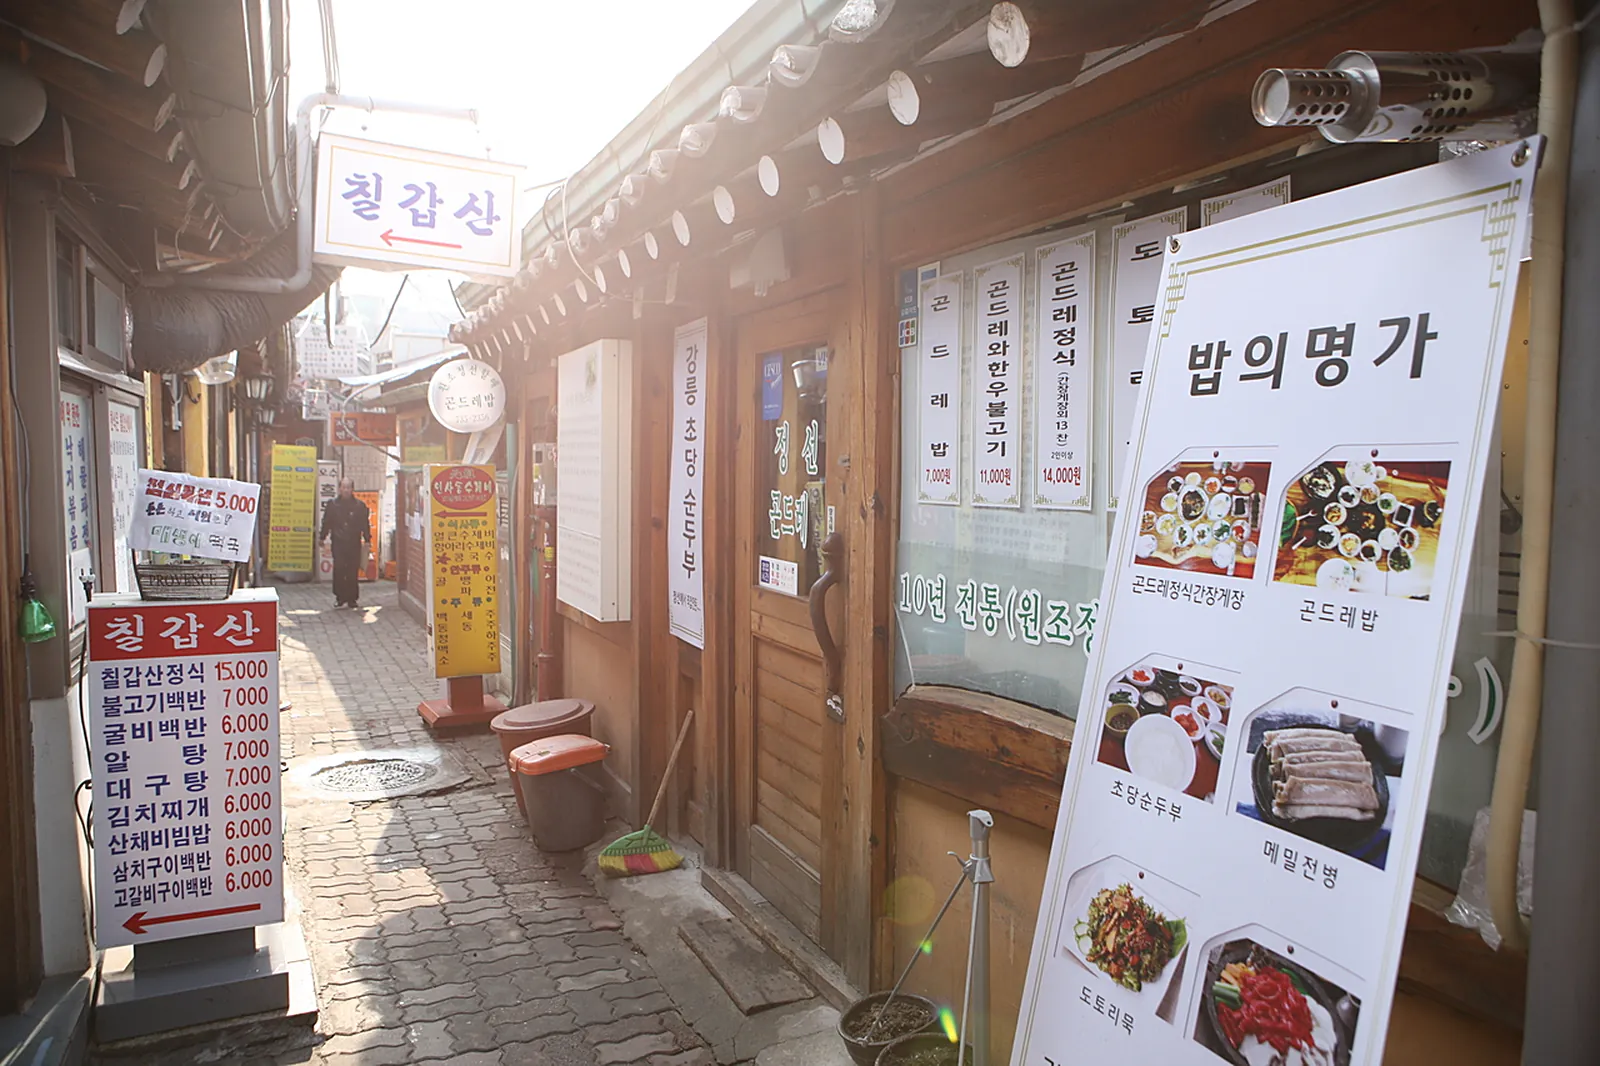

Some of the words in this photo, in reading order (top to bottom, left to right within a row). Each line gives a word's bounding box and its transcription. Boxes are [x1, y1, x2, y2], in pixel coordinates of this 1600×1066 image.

[341, 172, 501, 236] 칠갑산
[1051, 261, 1079, 367] 곤드레정식
[930, 294, 951, 458] 곤드레밥
[986, 279, 1010, 458] 곤드레와한우불고기
[445, 393, 495, 410] 곤드레밥
[434, 480, 492, 495] 인사동수제비
[925, 468, 951, 485] 7,000원
[980, 467, 1011, 486] 11,000원
[1042, 466, 1081, 486] 14,000원
[215, 491, 256, 514] 5.000
[434, 541, 494, 552] 항아리수제비
[148, 573, 217, 587] PROVENCE
[450, 564, 481, 575] 안주류
[899, 573, 946, 622] 10년
[1131, 575, 1245, 610] 곤드레정식간장게장
[104, 610, 260, 651] 칠갑산
[1300, 599, 1379, 632] 곤드레밥
[100, 662, 205, 689] 칠갑산정식
[214, 660, 269, 682] 15.000
[102, 689, 206, 718] 불고기백반
[103, 716, 207, 745] 굴비백반
[221, 712, 269, 734] 6.000
[223, 739, 270, 761] 7.000
[225, 765, 271, 787] 7.000
[107, 796, 210, 828] 김치찌개
[223, 791, 271, 814] 6.000
[1110, 780, 1182, 823] 초당순두부
[108, 822, 211, 856] 산채비빔밥
[224, 817, 272, 840] 6.000
[112, 850, 212, 882] 삼치구이백반
[225, 843, 272, 867] 6.000
[1263, 840, 1339, 890] 메밀전병
[113, 876, 213, 908] 고갈비구이백반
[225, 869, 273, 892] 6.000
[1078, 985, 1136, 1036] 도토리묵
